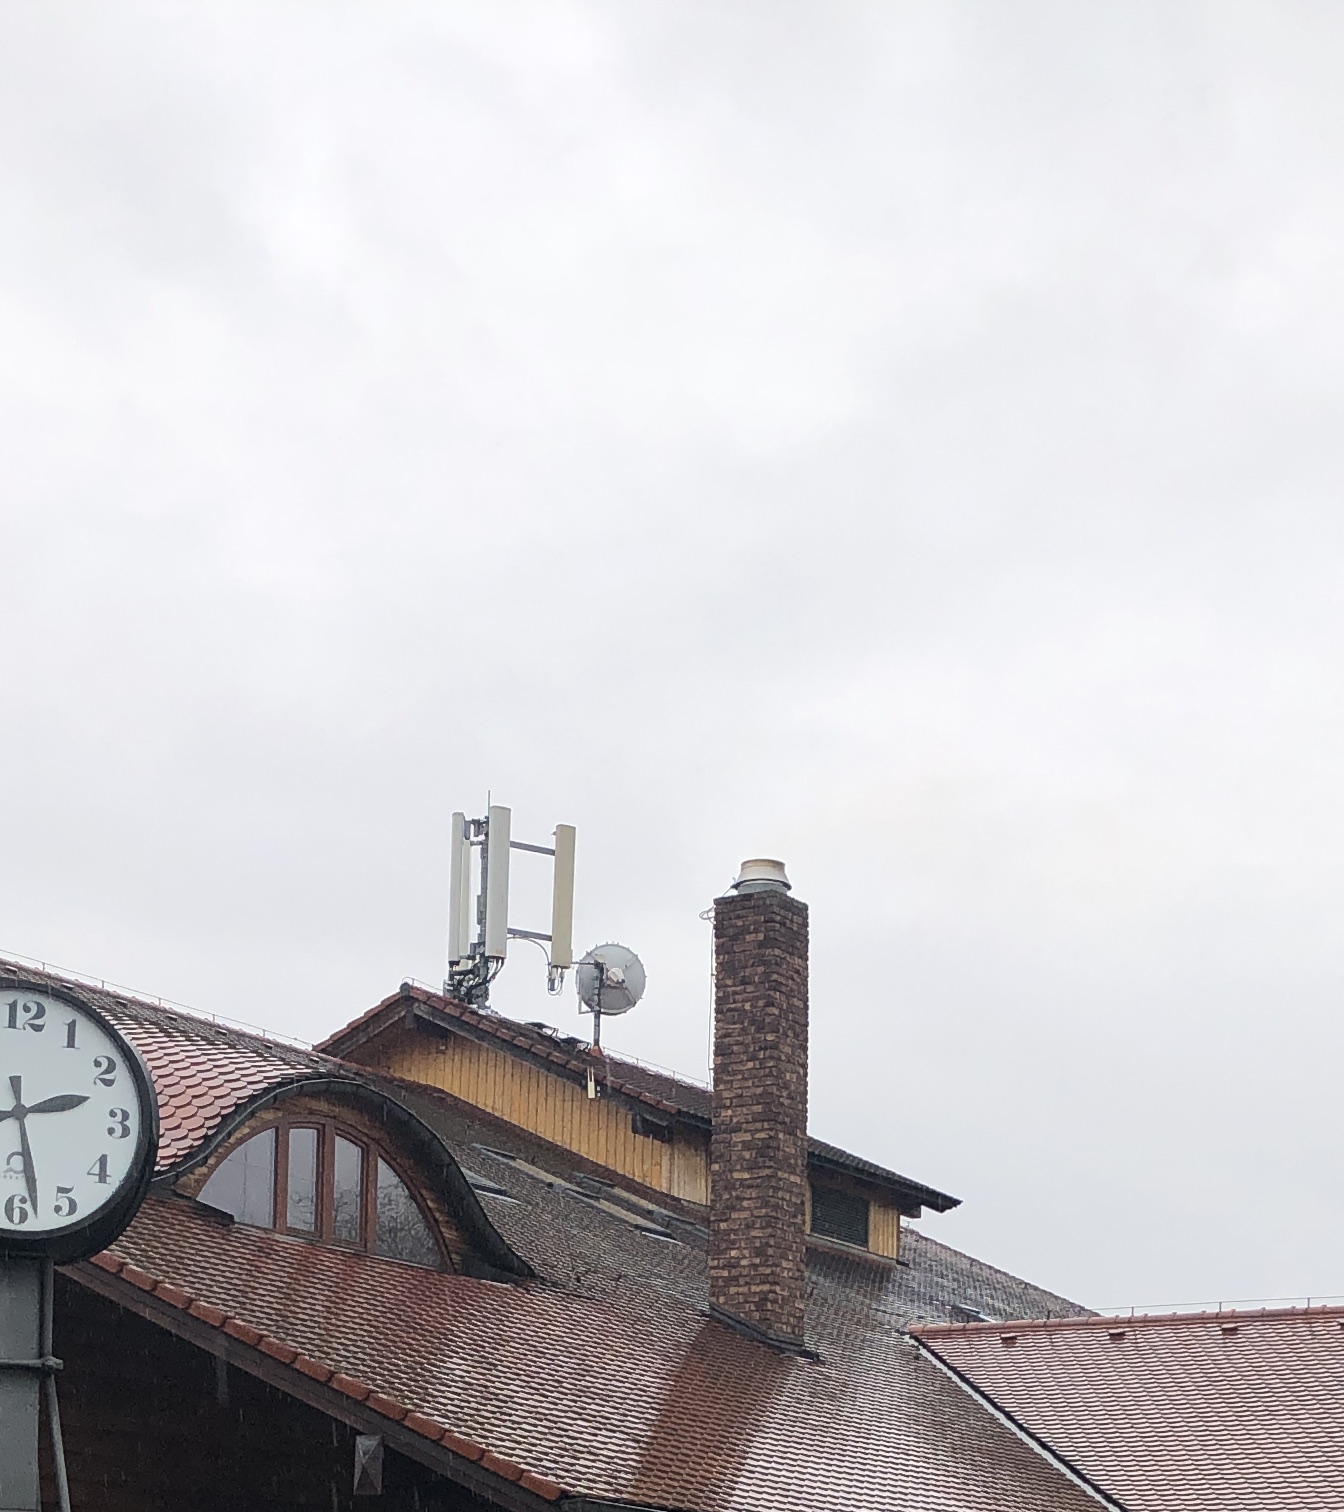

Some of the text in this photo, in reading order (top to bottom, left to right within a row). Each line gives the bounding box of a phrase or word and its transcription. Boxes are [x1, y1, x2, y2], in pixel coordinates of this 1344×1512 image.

[5, 999, 47, 1033] 12
[62, 1019, 80, 1049] 1
[93, 1055, 117, 1087] 2
[107, 1107, 131, 1139] 3
[87, 1154, 111, 1185] 4
[4, 1194, 29, 1226] 6
[54, 1186, 78, 1217] 5
